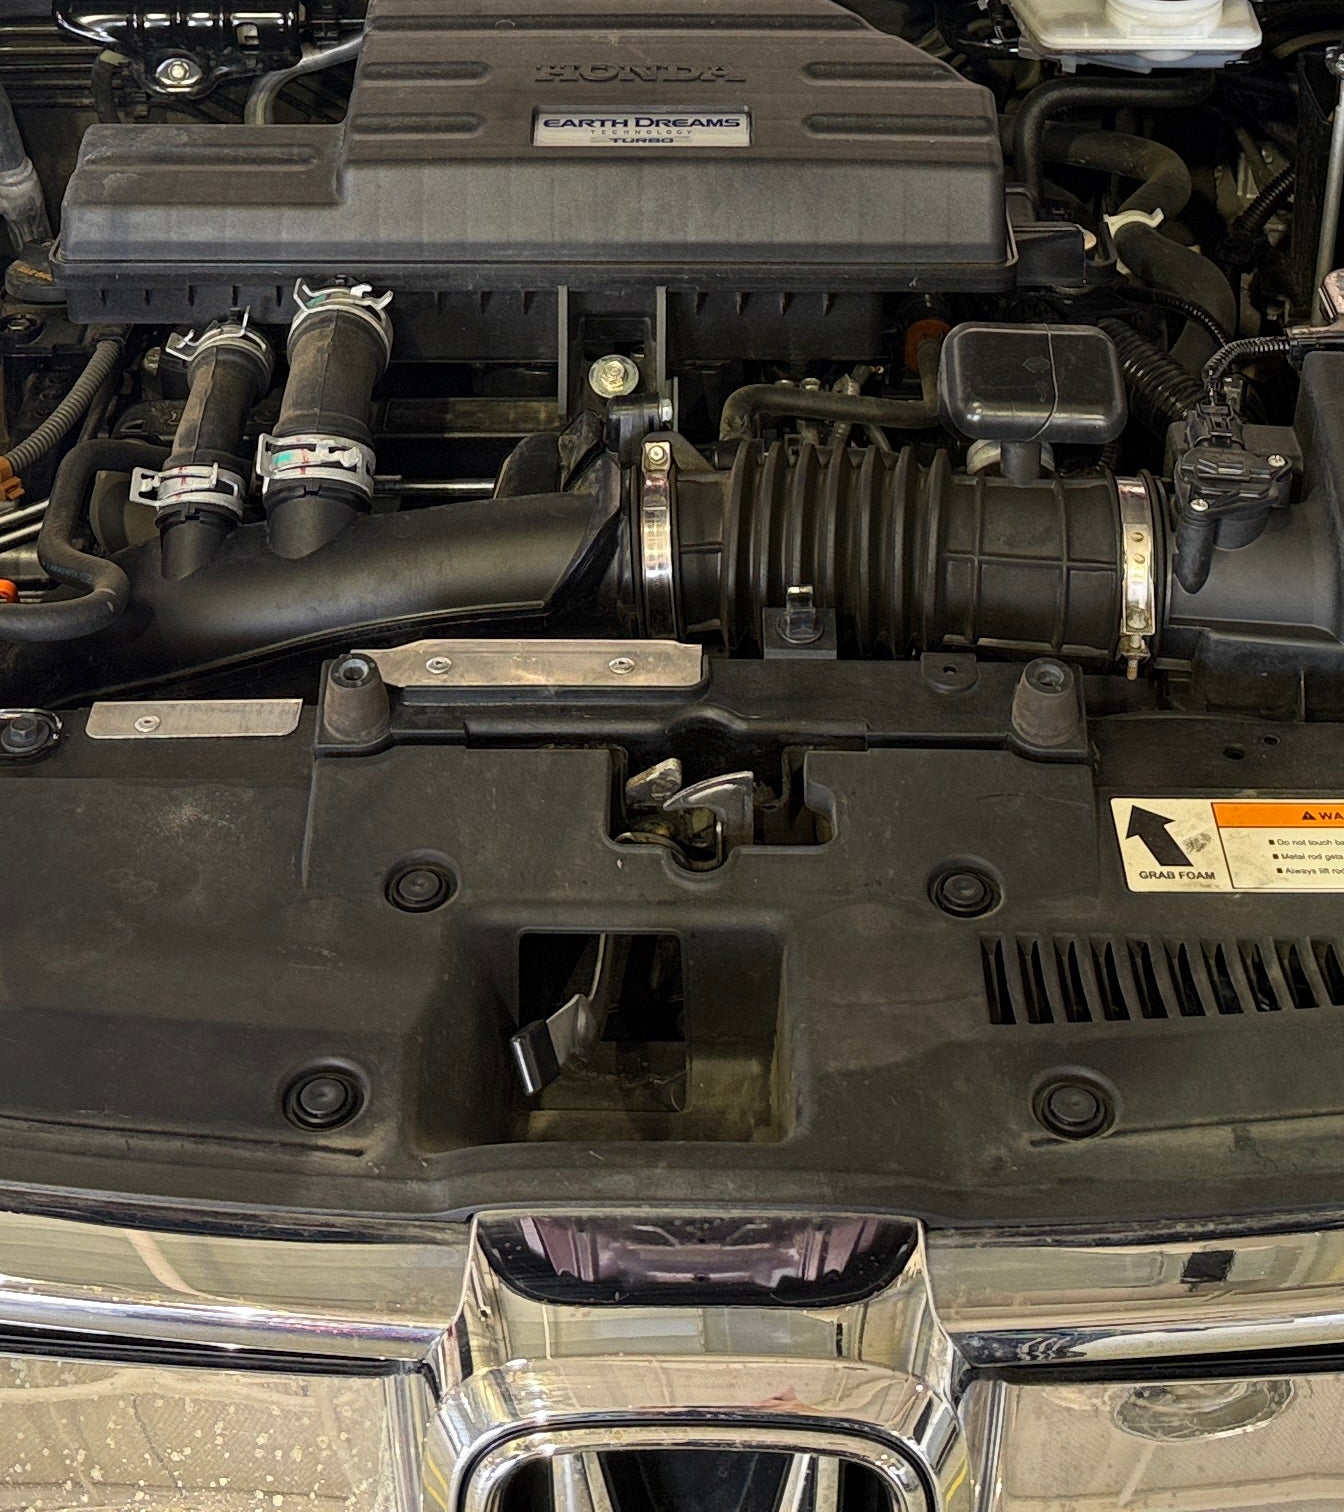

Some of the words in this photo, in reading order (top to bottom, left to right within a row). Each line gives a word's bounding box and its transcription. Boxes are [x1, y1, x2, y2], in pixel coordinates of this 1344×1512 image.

[535, 64, 746, 82] HONDA
[543, 118, 631, 128] EARTH
[635, 117, 741, 128] DREAMS
[1139, 870, 1176, 880] GRAB
[1179, 870, 1216, 880] FOAM
[1285, 867, 1317, 875] Always
